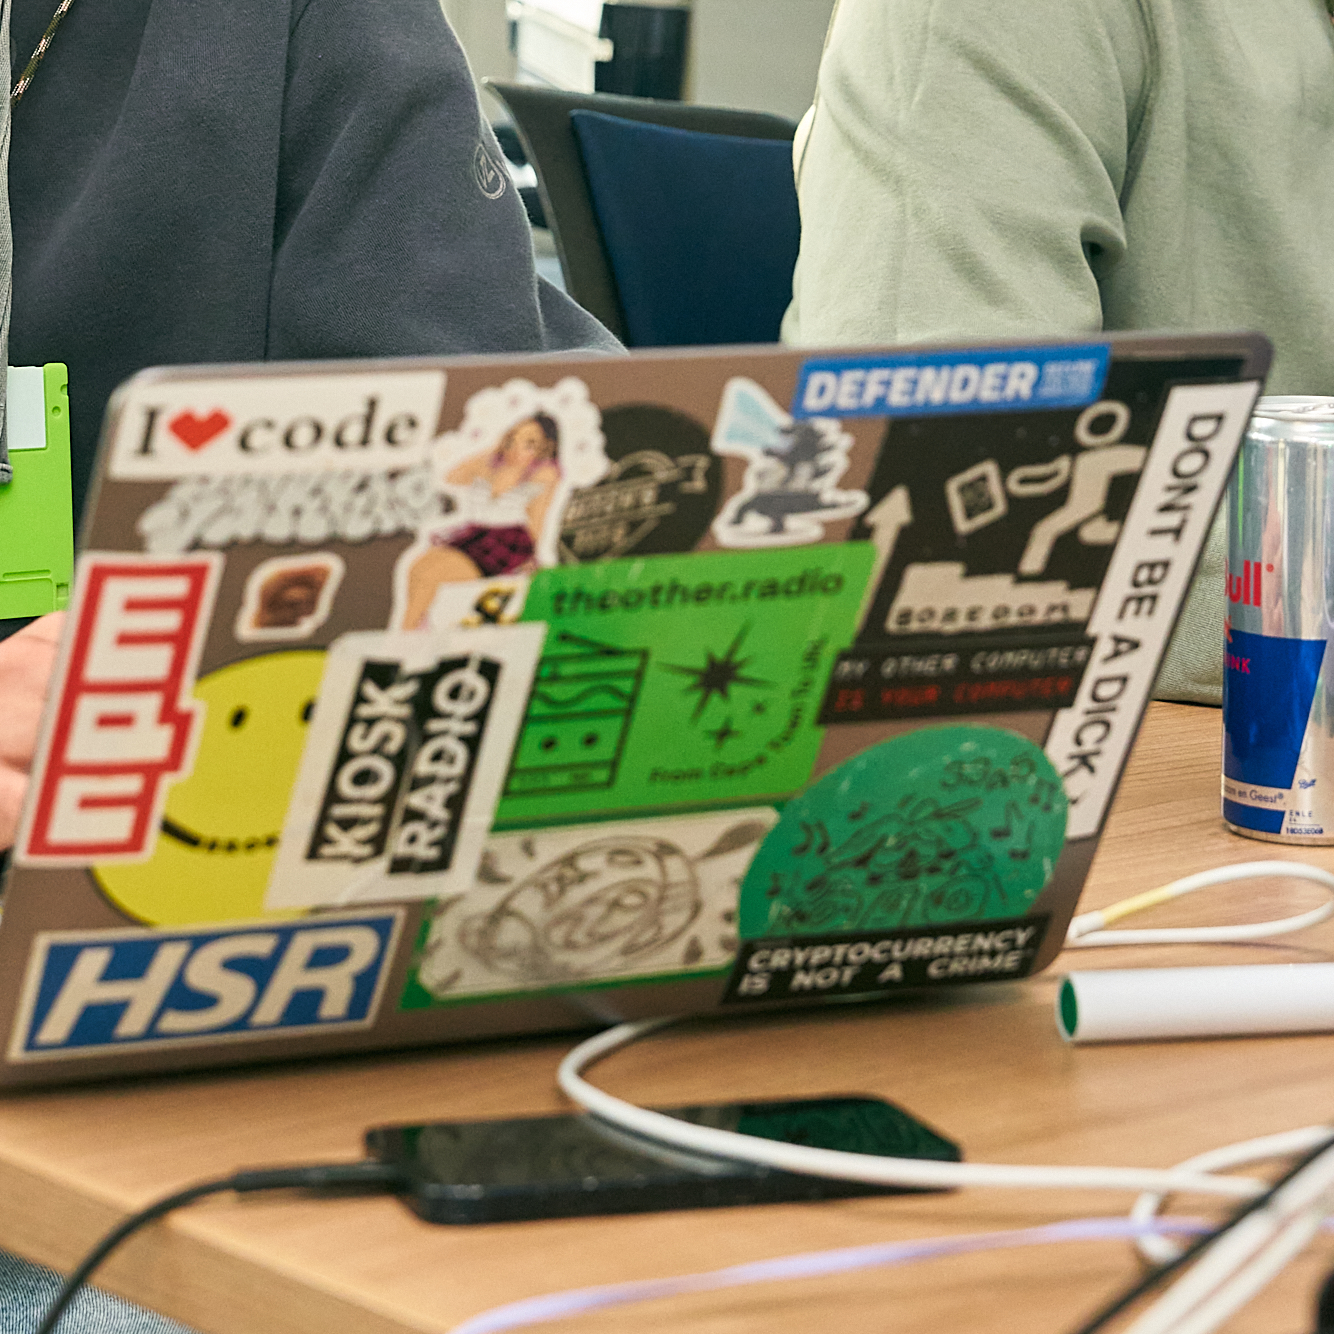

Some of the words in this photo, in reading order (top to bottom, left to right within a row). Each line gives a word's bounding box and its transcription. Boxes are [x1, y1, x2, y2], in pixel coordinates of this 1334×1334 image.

[802, 361, 1039, 413] DEFENDER
[136, 404, 164, 457] I
[237, 396, 420, 454] code
[1117, 556, 1171, 622] BE
[1224, 557, 1263, 608] ull
[880, 653, 961, 678] OTHER
[970, 645, 1093, 675] COMPUTER
[1100, 632, 1141, 664] A
[45, 575, 193, 846] npm
[1062, 674, 1130, 786] DICK
[318, 676, 422, 863] KIOSK
[396, 662, 493, 863] RADIO
[736, 971, 772, 996] IS
[789, 965, 862, 992] NOT
[876, 962, 905, 983] A
[925, 950, 1026, 980] CRIME
[746, 925, 1036, 973] CRYPTOCURRENCY
[34, 924, 382, 1047] HSR
